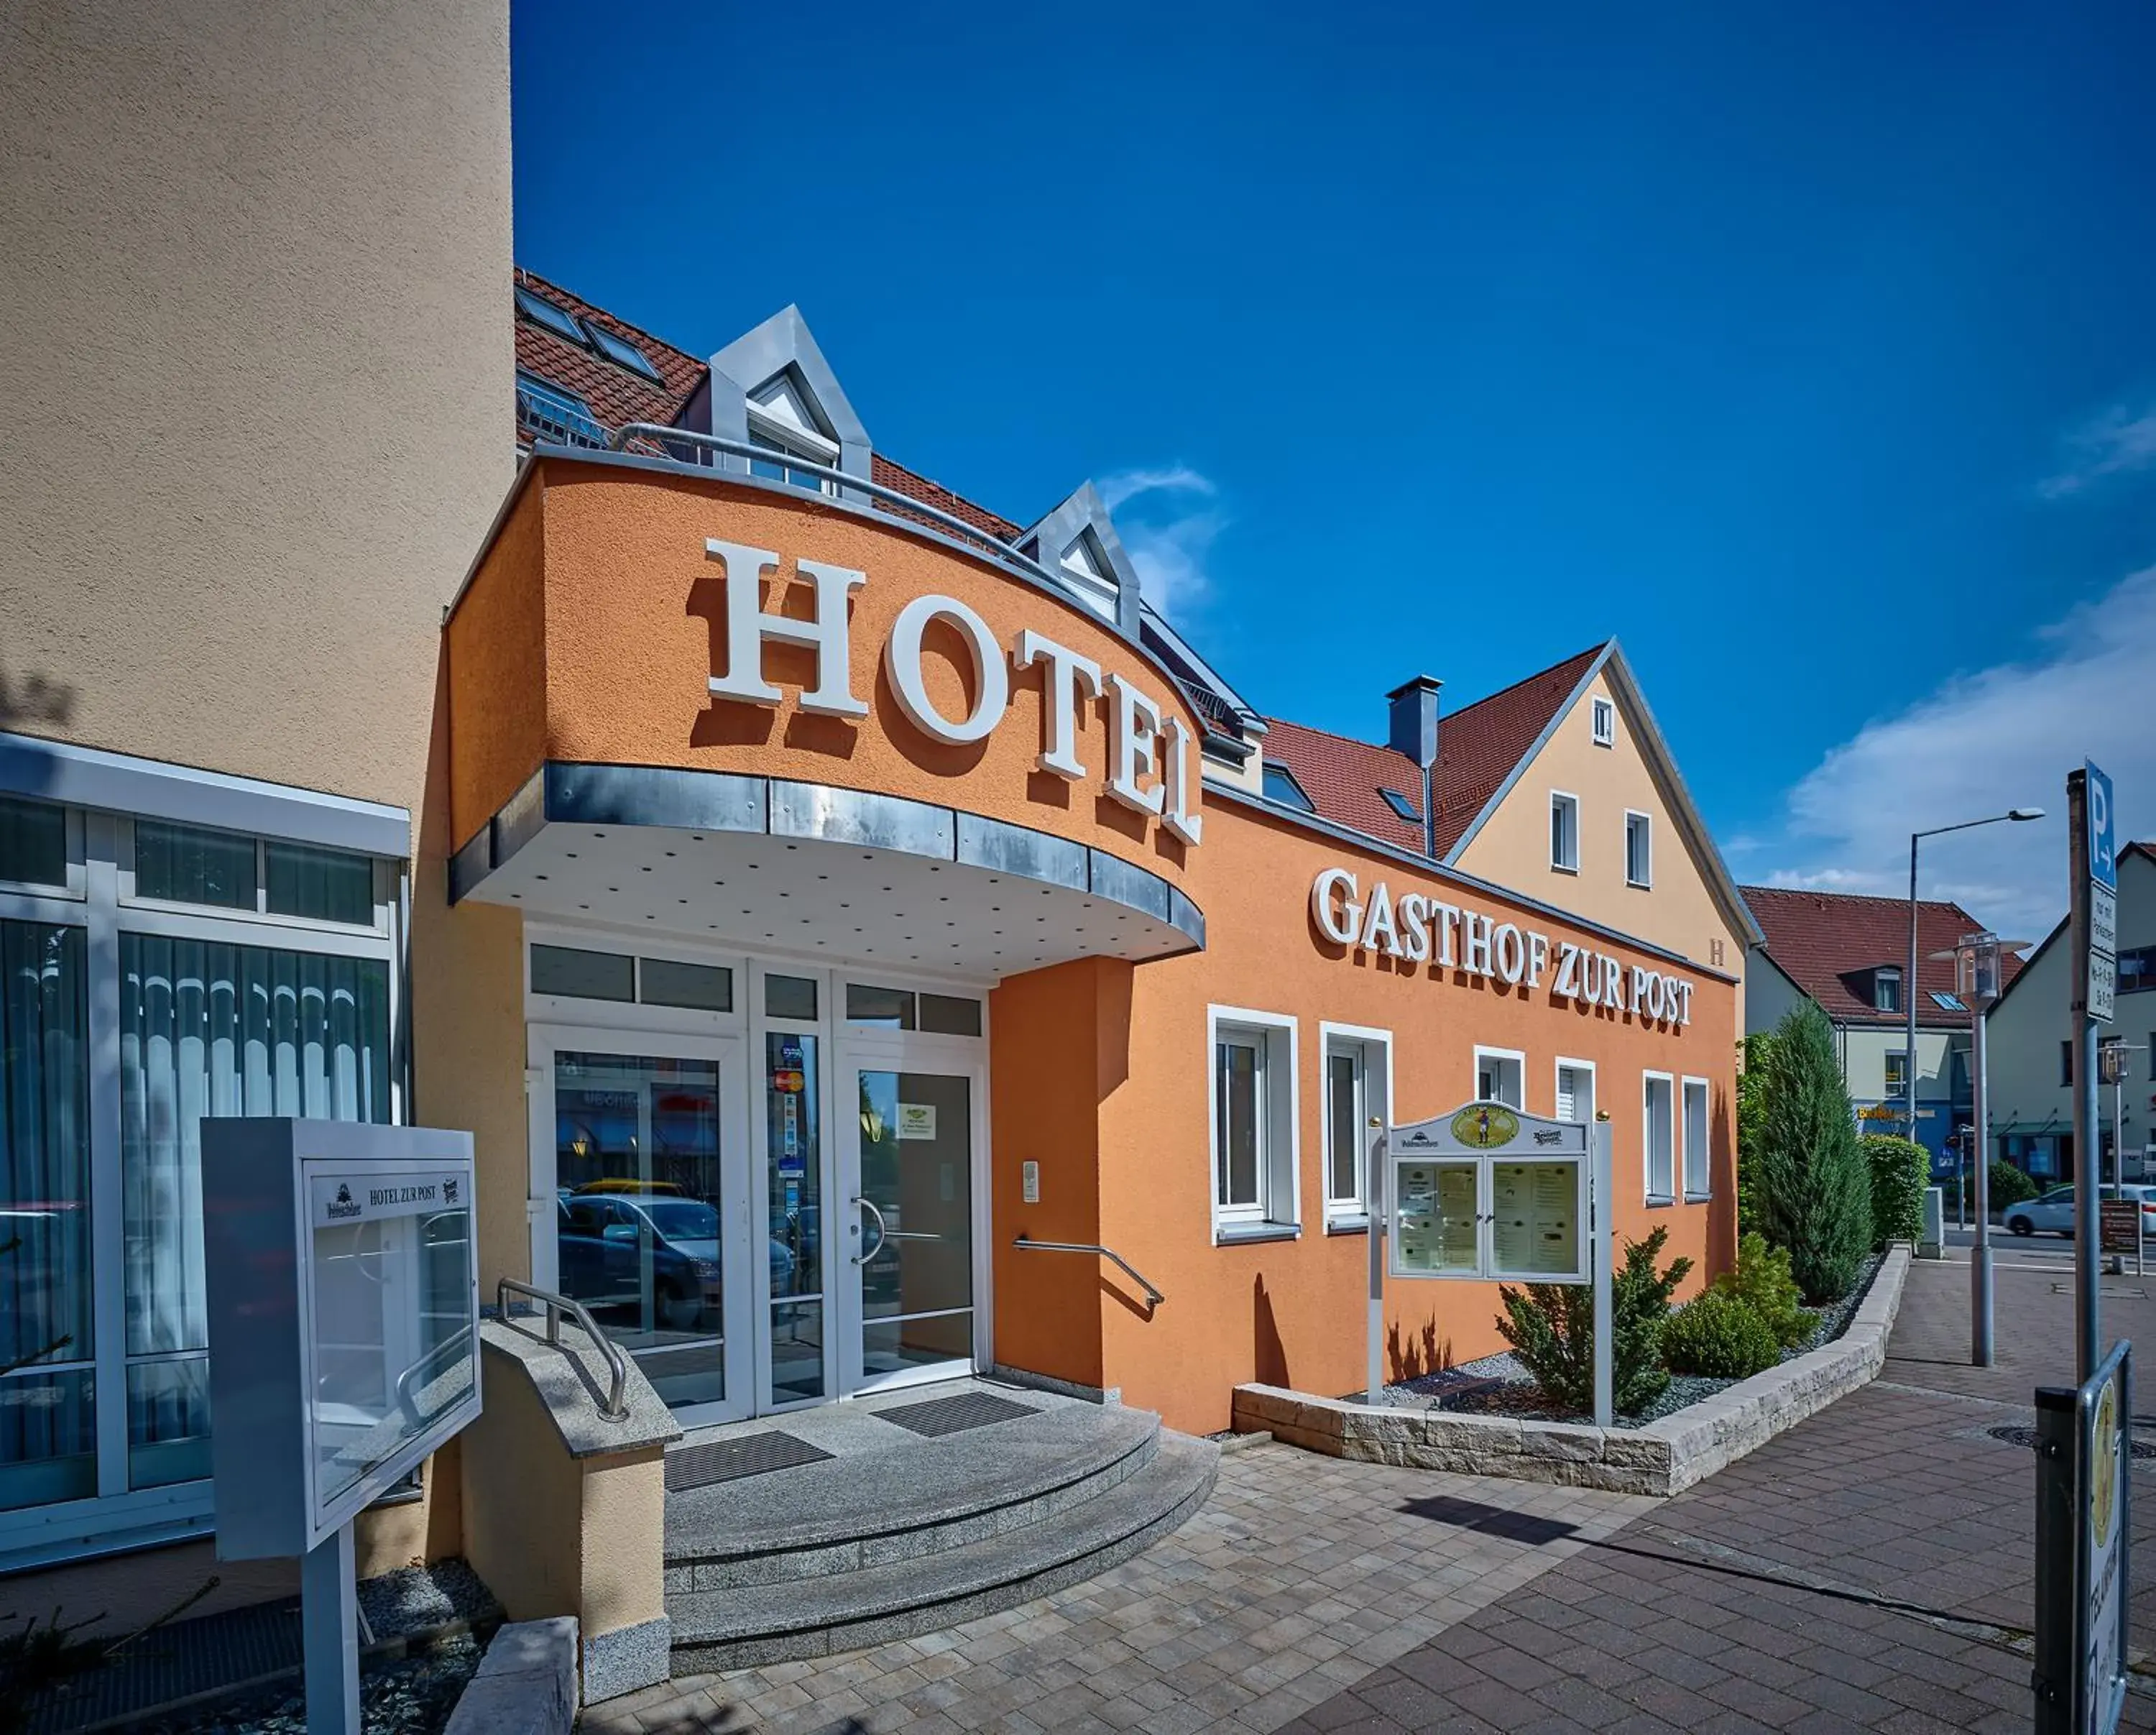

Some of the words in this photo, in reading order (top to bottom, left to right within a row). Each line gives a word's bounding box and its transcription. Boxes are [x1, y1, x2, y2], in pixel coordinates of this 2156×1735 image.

[704, 537, 1204, 847] HOTEL
[2091, 777, 2106, 863] P
[1312, 868, 1549, 990] GASTHOF
[1553, 941, 1625, 1010] ZUR
[1627, 965, 1695, 1026] POST
[370, 1189, 399, 1206] HOTEL
[400, 1187, 418, 1203] ZUR
[418, 1185, 437, 1201] POST
